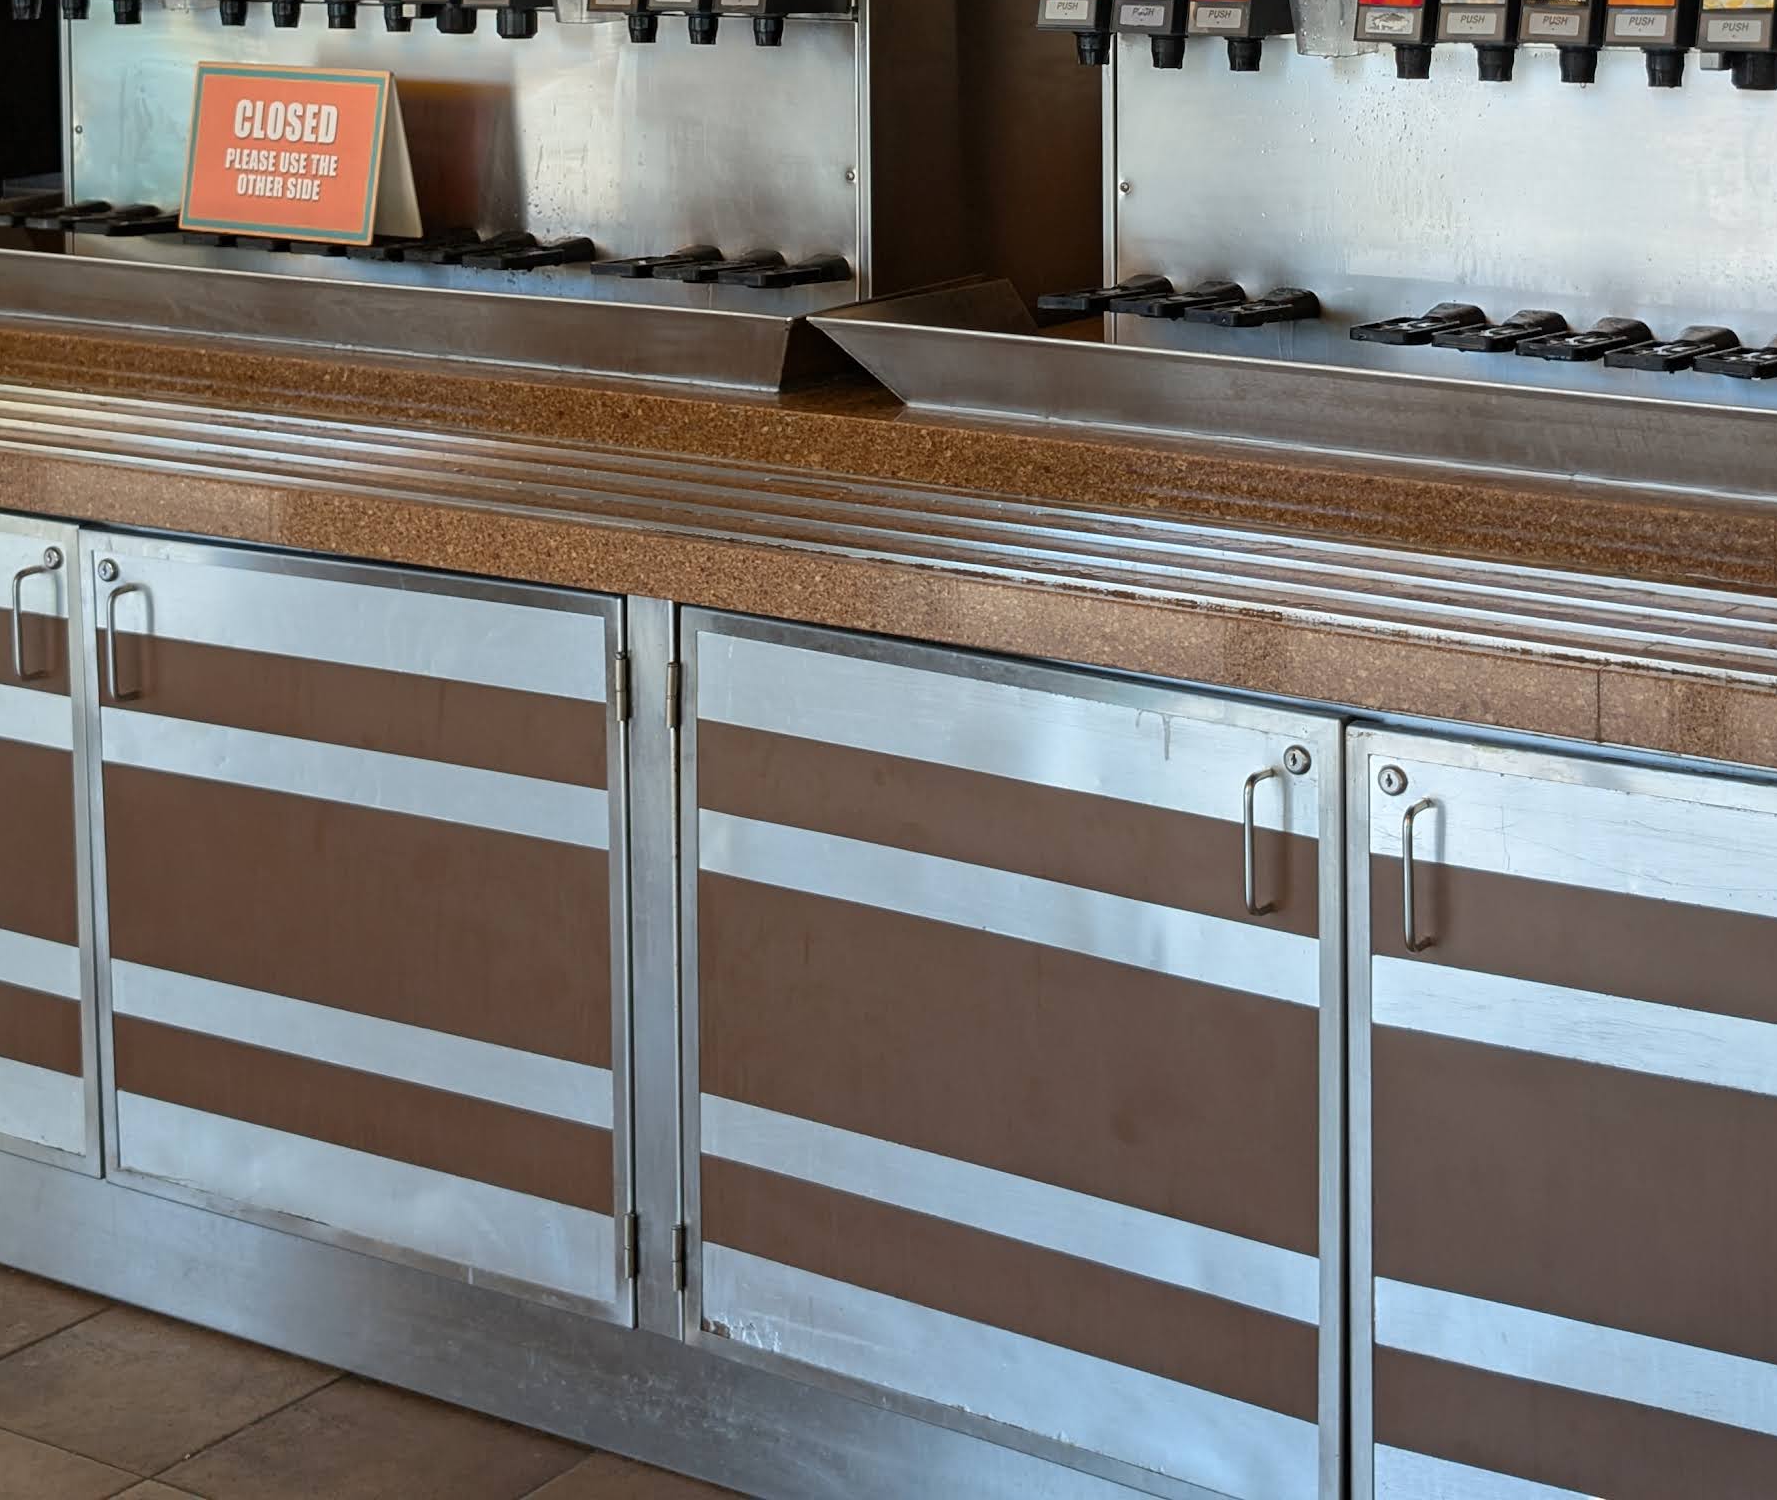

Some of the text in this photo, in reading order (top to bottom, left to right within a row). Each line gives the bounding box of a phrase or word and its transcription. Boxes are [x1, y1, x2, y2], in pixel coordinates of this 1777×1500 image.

[1056, 1, 1079, 11] PUSH
[1208, 10, 1231, 19] PUSH
[1460, 14, 1486, 24] PUSH
[1542, 15, 1568, 26] PUSH
[1628, 16, 1655, 27] PUSH
[1721, 22, 1750, 32] PUSH
[234, 99, 338, 144] CLOSED
[225, 148, 339, 177] PLEASE USE THE
[237, 174, 321, 201] OTHER SIDE
